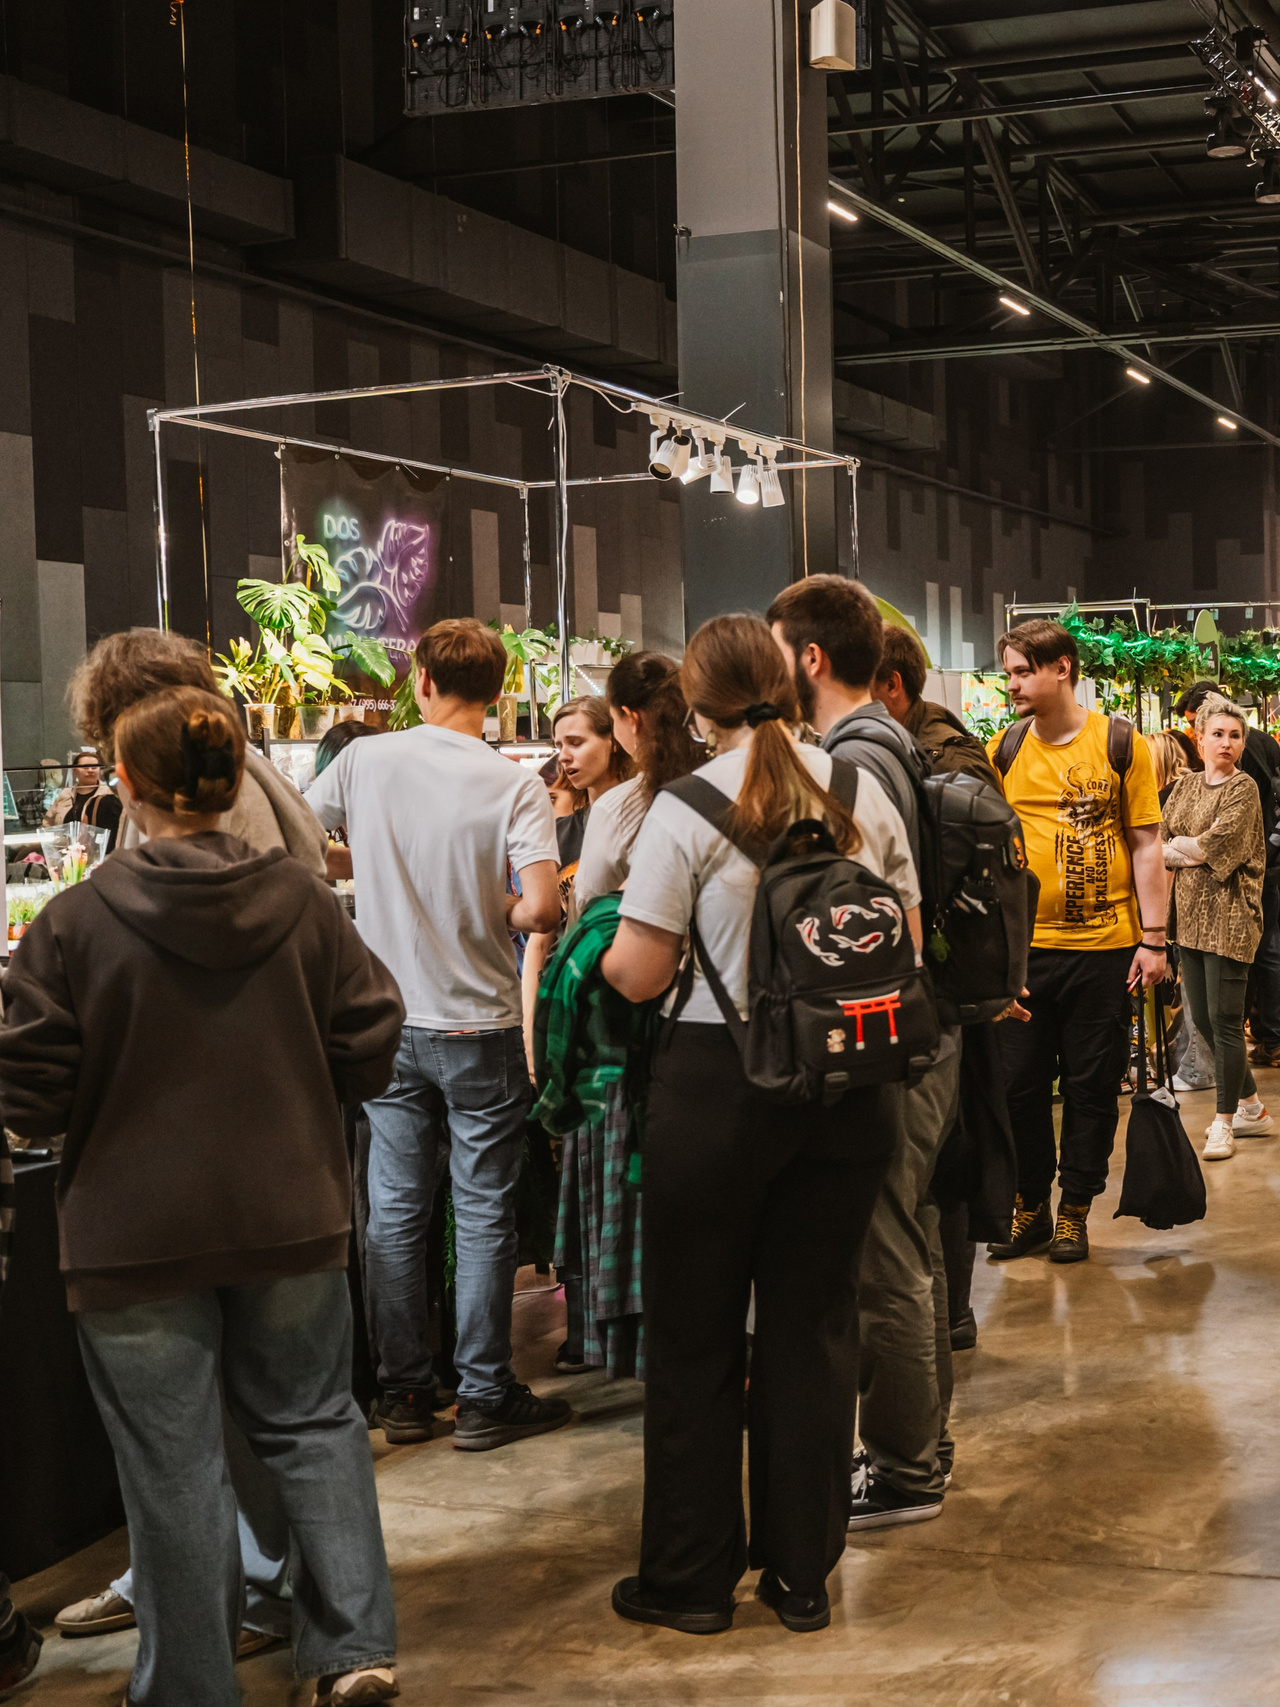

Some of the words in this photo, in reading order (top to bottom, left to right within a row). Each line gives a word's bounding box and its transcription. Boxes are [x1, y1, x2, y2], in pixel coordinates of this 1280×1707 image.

[323, 514, 360, 541] DOS
[1086, 781, 1109, 793] CORE
[1085, 866, 1095, 884] AND
